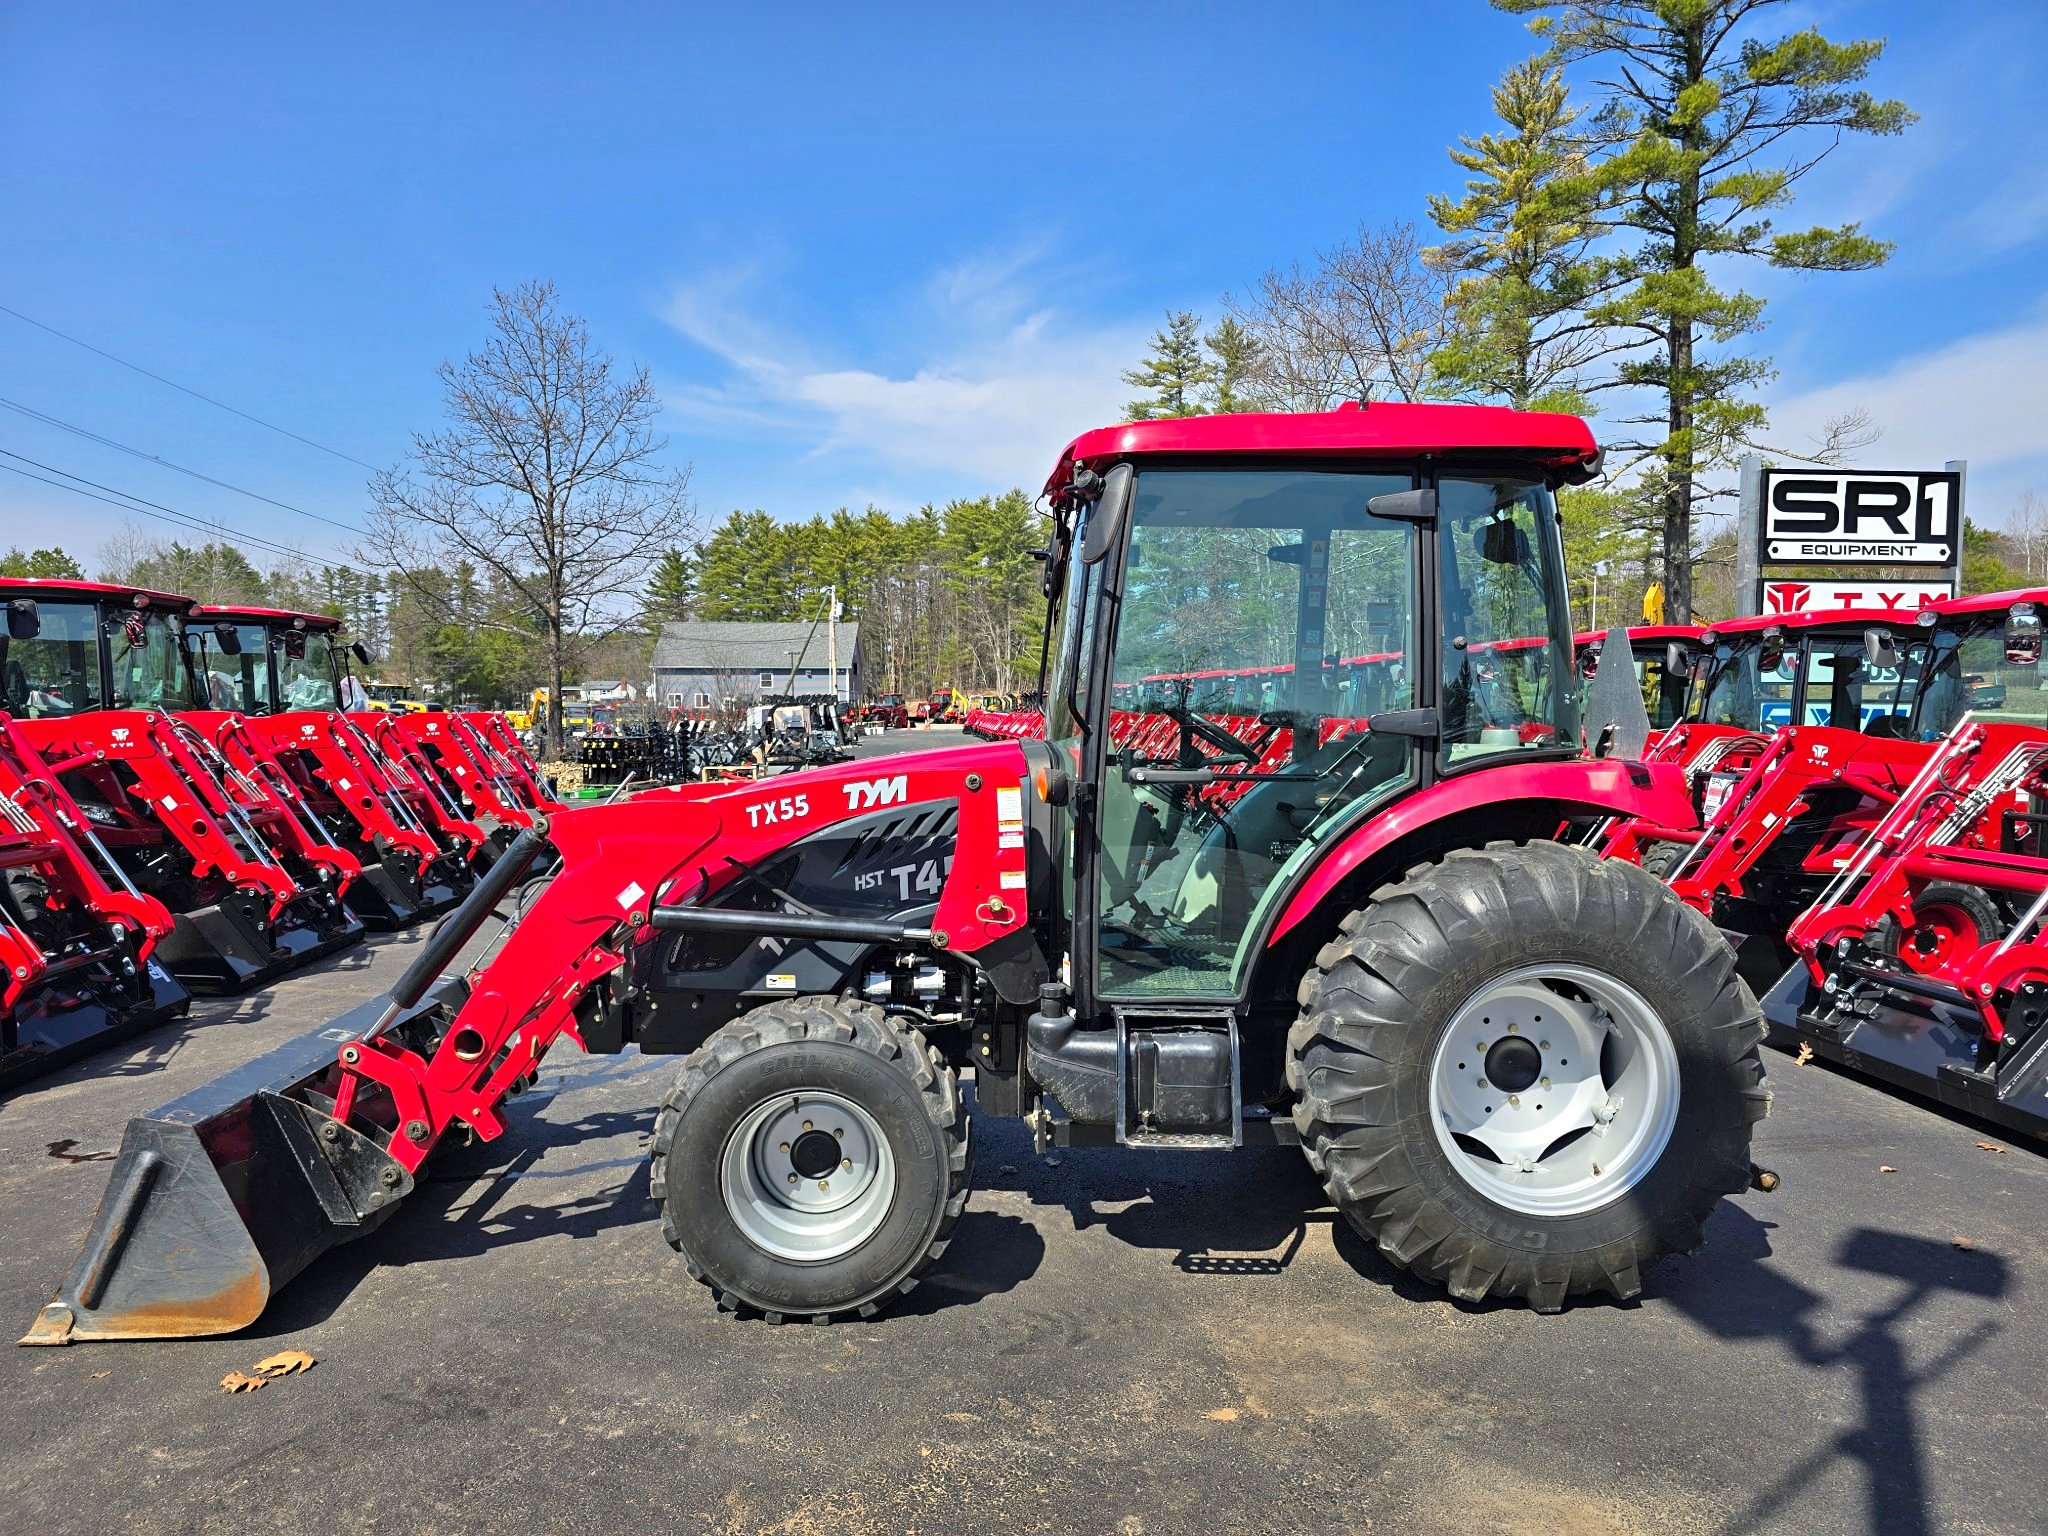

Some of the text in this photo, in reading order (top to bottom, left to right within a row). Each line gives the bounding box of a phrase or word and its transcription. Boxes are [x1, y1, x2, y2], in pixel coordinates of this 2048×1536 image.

[1772, 479, 1949, 536] SR1
[1801, 544, 1918, 556] EQUIPMENT
[1833, 592, 1949, 610] TYM
[842, 775, 908, 810] TYM
[745, 794, 810, 828] TX55
[854, 854, 956, 901] HST T4
[758, 1053, 876, 1084] CARLISLE
[1403, 1117, 1549, 1250] CARLISLE
